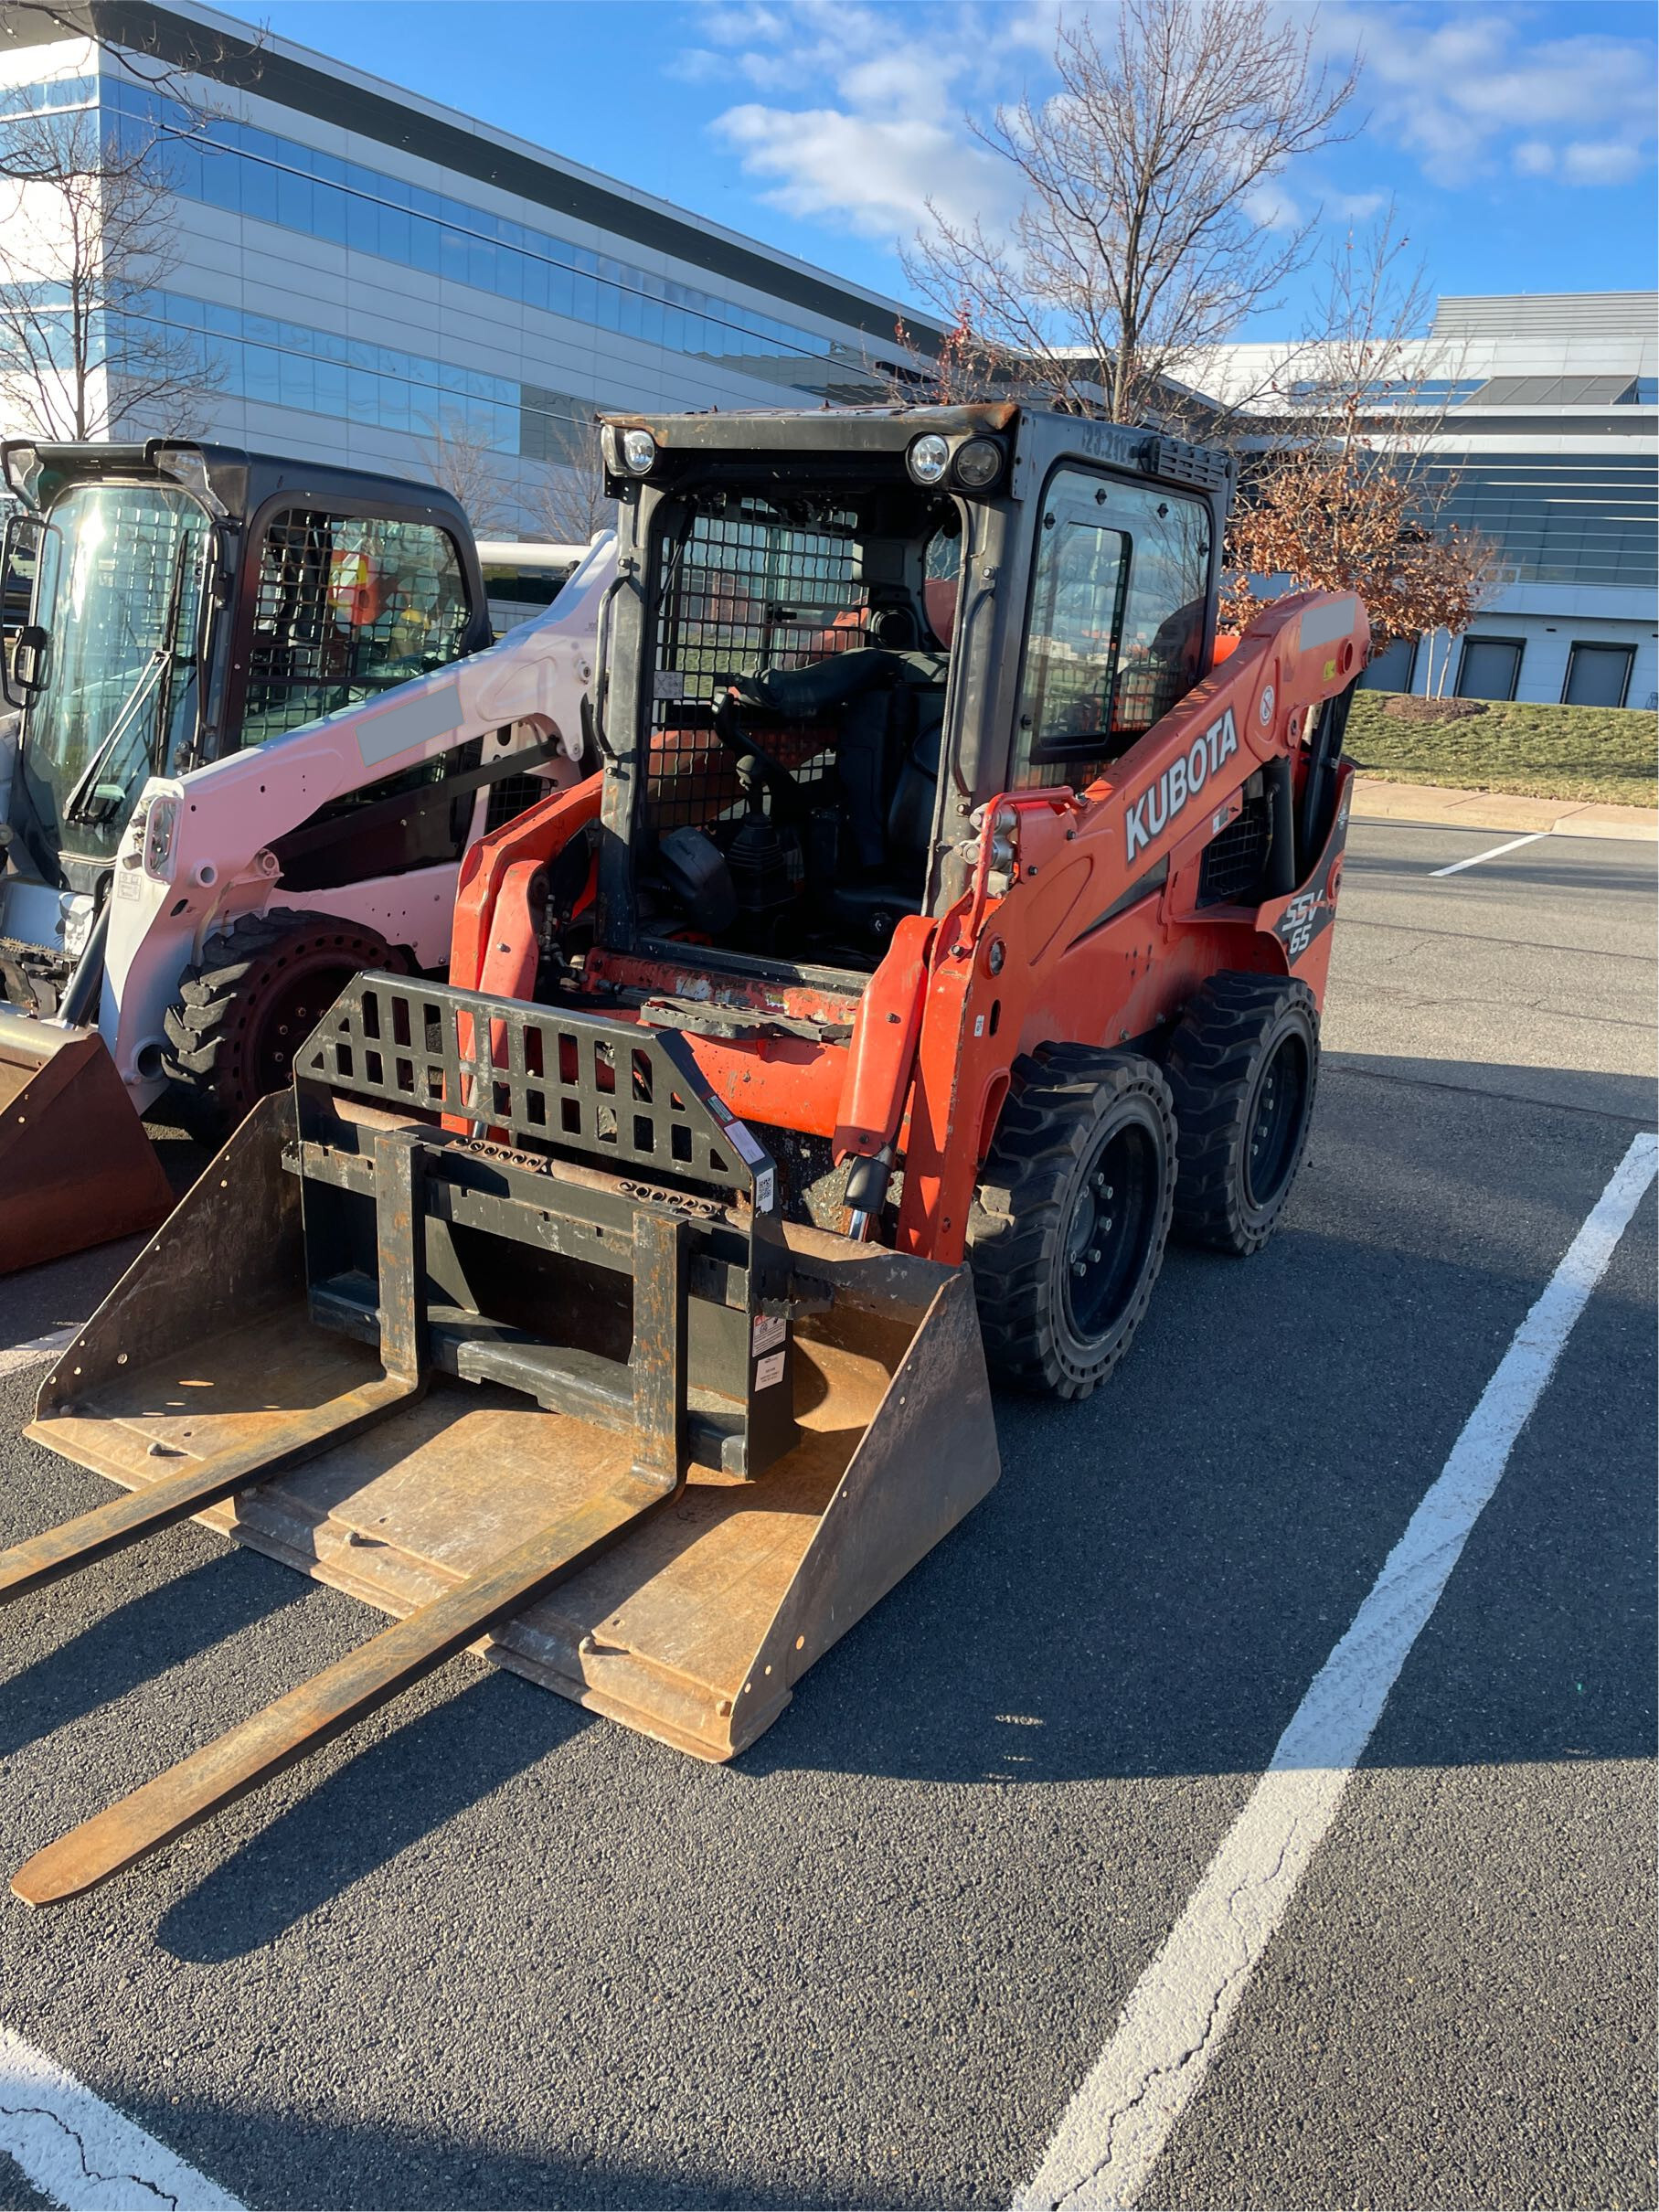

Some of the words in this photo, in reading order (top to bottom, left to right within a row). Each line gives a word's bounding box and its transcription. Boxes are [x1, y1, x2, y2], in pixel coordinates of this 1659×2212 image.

[1125, 707, 1238, 862] KUBOTA
[1281, 889, 1324, 931] SSV
[1290, 924, 1313, 954] 65
